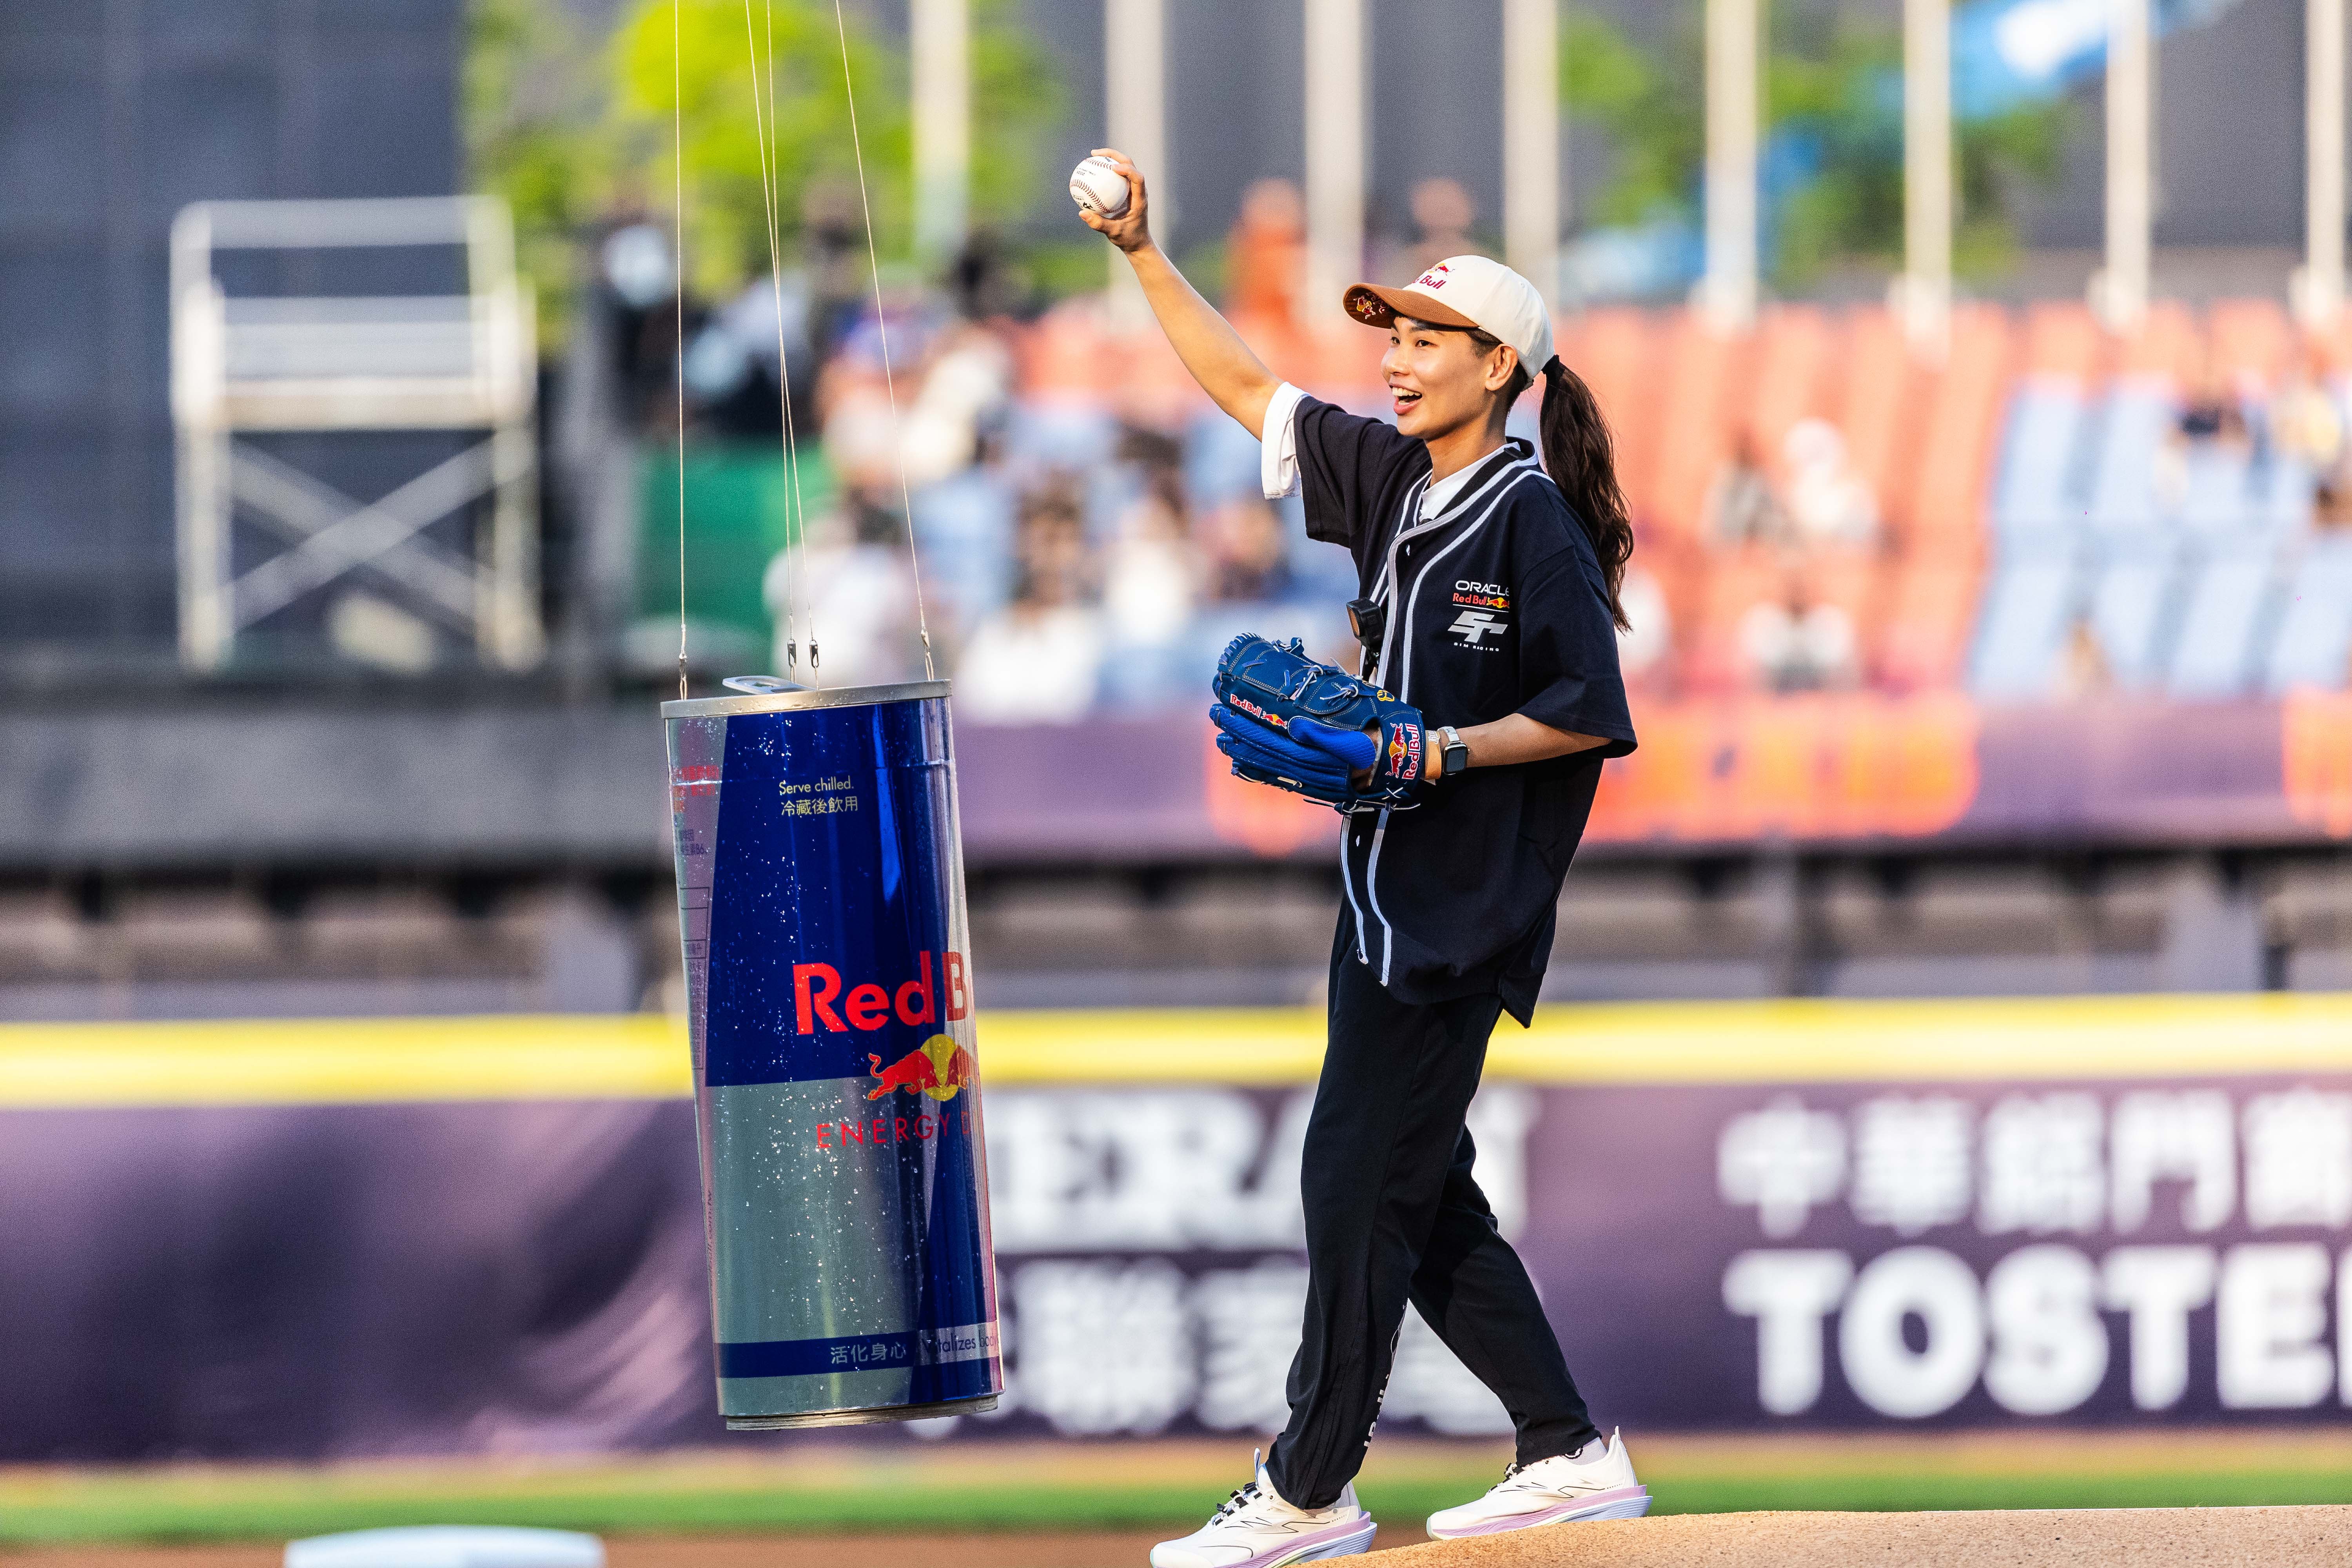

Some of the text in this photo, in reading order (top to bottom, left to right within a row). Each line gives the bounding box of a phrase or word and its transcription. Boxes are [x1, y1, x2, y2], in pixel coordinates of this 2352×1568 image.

[1453, 593, 1487, 605] Red Bull
[1230, 693, 1262, 718] Red Bull
[1402, 723, 1421, 780] Red Bull
[779, 775, 854, 795] Serve chilled.
[781, 796, 858, 817] 冷藏後飲用
[793, 950, 936, 1035] Red
[816, 1112, 951, 1149] ENERGY
[1721, 1242, 2352, 1419] TOSTE
[831, 1341, 907, 1365] 活化身心
